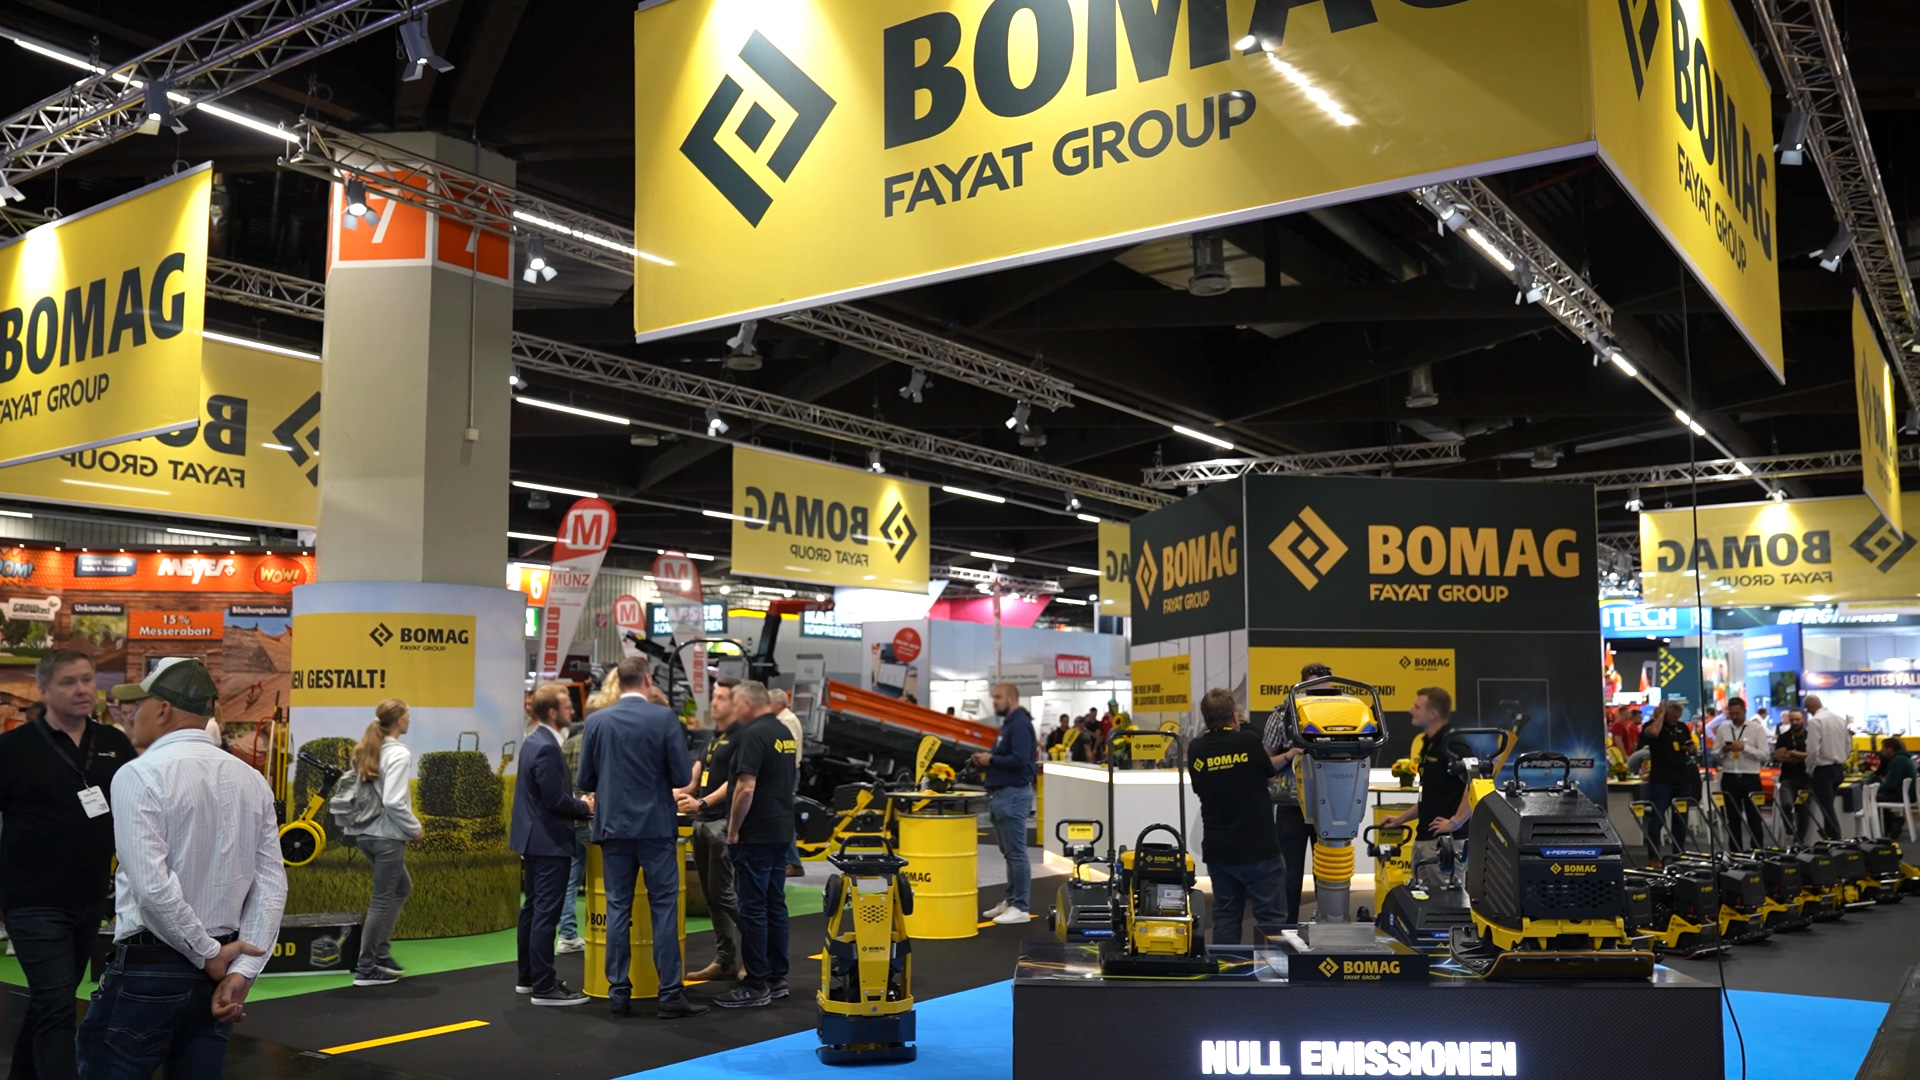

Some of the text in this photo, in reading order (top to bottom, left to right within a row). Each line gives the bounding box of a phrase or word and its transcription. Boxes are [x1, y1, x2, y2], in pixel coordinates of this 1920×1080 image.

[884, 0, 1470, 149] BOMA
[1670, 0, 1772, 261] BOMAG
[884, 89, 1257, 218] FAYAT GROUP
[369, 188, 399, 244] 7
[1677, 142, 1747, 275] FAYAT GROUP
[0, 252, 186, 384] BOMAG
[47, 373, 109, 413] GROUP
[572, 514, 604, 546] M
[1162, 525, 1238, 592] BOMAG
[1368, 525, 1581, 578] BOMAG
[0, 558, 33, 577] OM!
[552, 571, 590, 586] MÜNZ
[530, 570, 543, 599] 6
[1369, 584, 1510, 603] FAYAT GROUP
[620, 604, 636, 622] M
[1163, 590, 1210, 615] FAYAT GROUP
[163, 614, 190, 625] 15 %
[140, 626, 211, 637] Messerabatt
[400, 627, 469, 644] BOMAG
[1057, 659, 1090, 675] WINTER
[1414, 658, 1450, 667] BOMAG
[307, 669, 386, 689] GESTALT!
[1206, 752, 1249, 768] BOMAG
[1563, 864, 1597, 873] BOMAG
[1343, 960, 1400, 973] BOMAG
[1201, 1040, 1517, 1077] NULL EMISSIONEN
